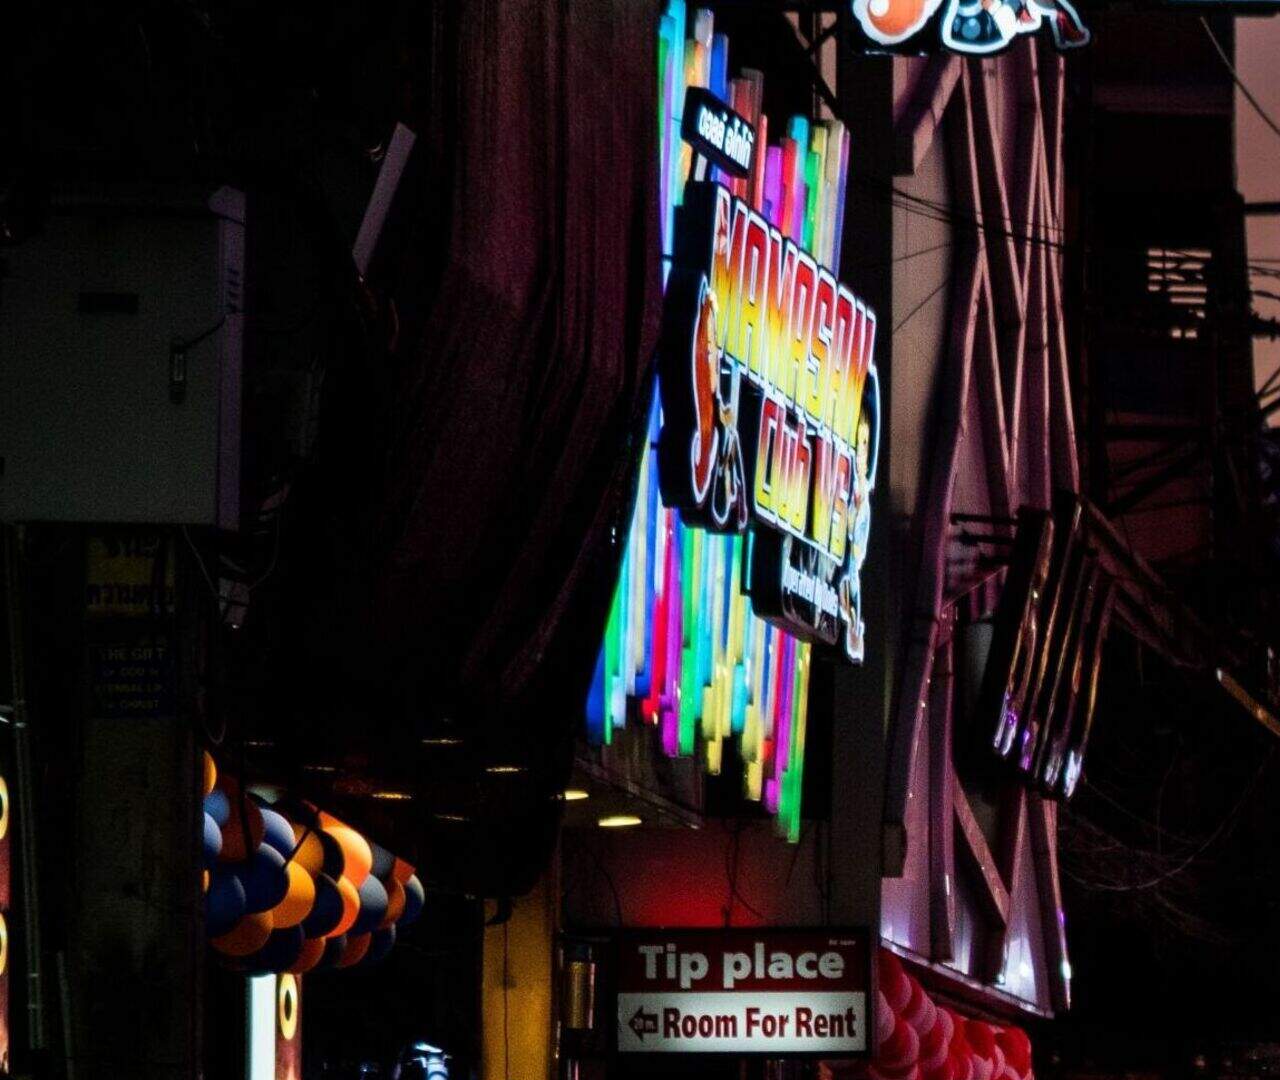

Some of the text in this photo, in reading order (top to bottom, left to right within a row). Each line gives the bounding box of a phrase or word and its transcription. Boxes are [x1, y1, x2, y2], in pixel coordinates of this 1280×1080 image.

[754, 392, 812, 540] Club
[638, 942, 845, 988] Tip place
[663, 1006, 857, 1039] Room For Rent
